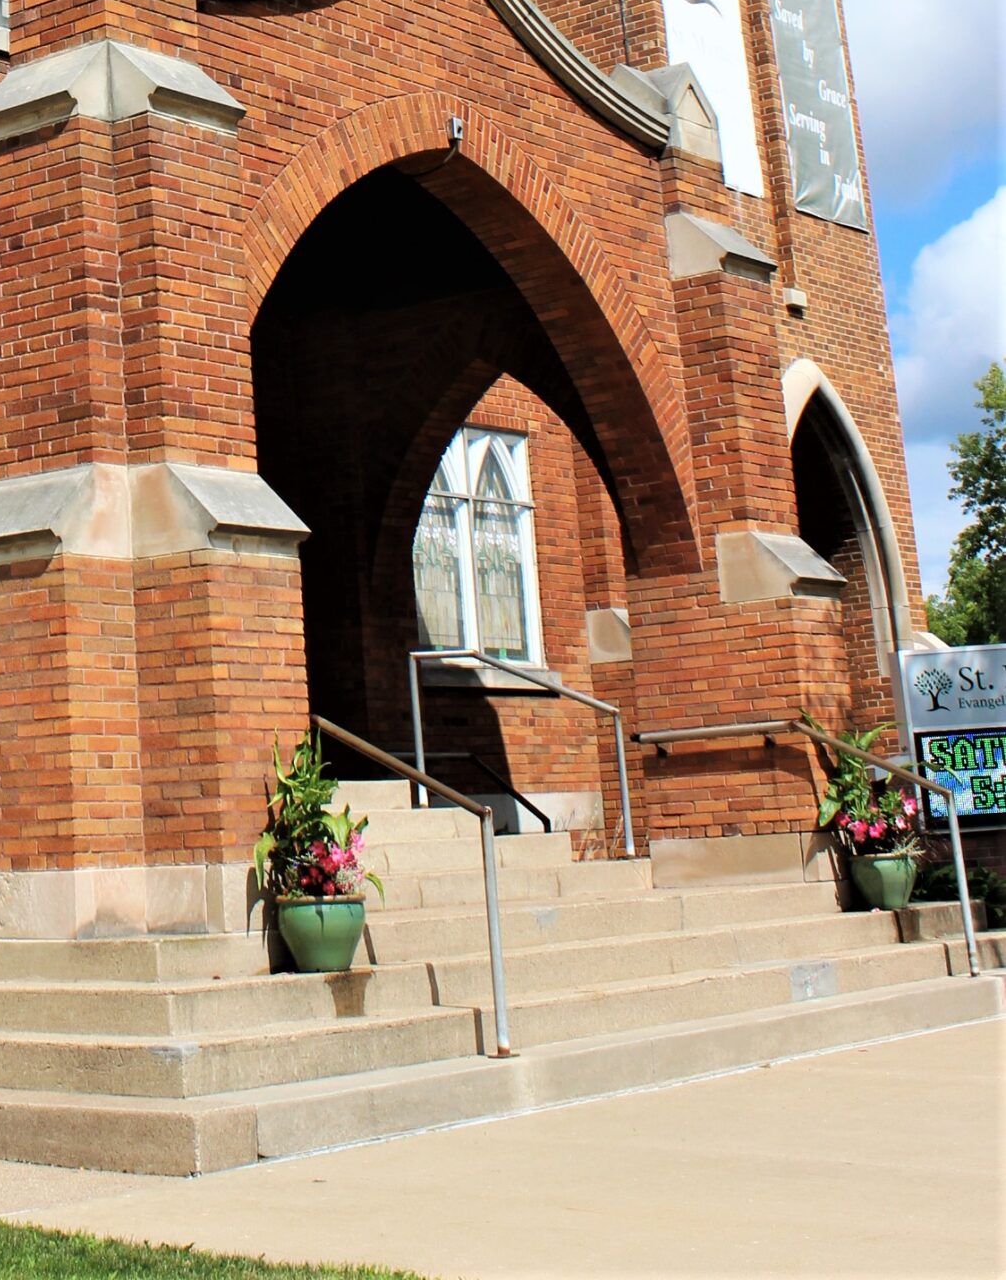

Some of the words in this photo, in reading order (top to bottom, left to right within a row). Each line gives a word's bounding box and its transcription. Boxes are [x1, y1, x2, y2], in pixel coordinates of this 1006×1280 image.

[774, 0, 804, 30] Saved
[802, 39, 815, 68] by
[818, 79, 847, 109] Grace
[789, 103, 826, 142] Serving
[819, 142, 830, 166] in
[958, 666, 994, 692] St.
[958, 694, 1006, 710] Evangel
[972, 777, 1006, 809] 5:
